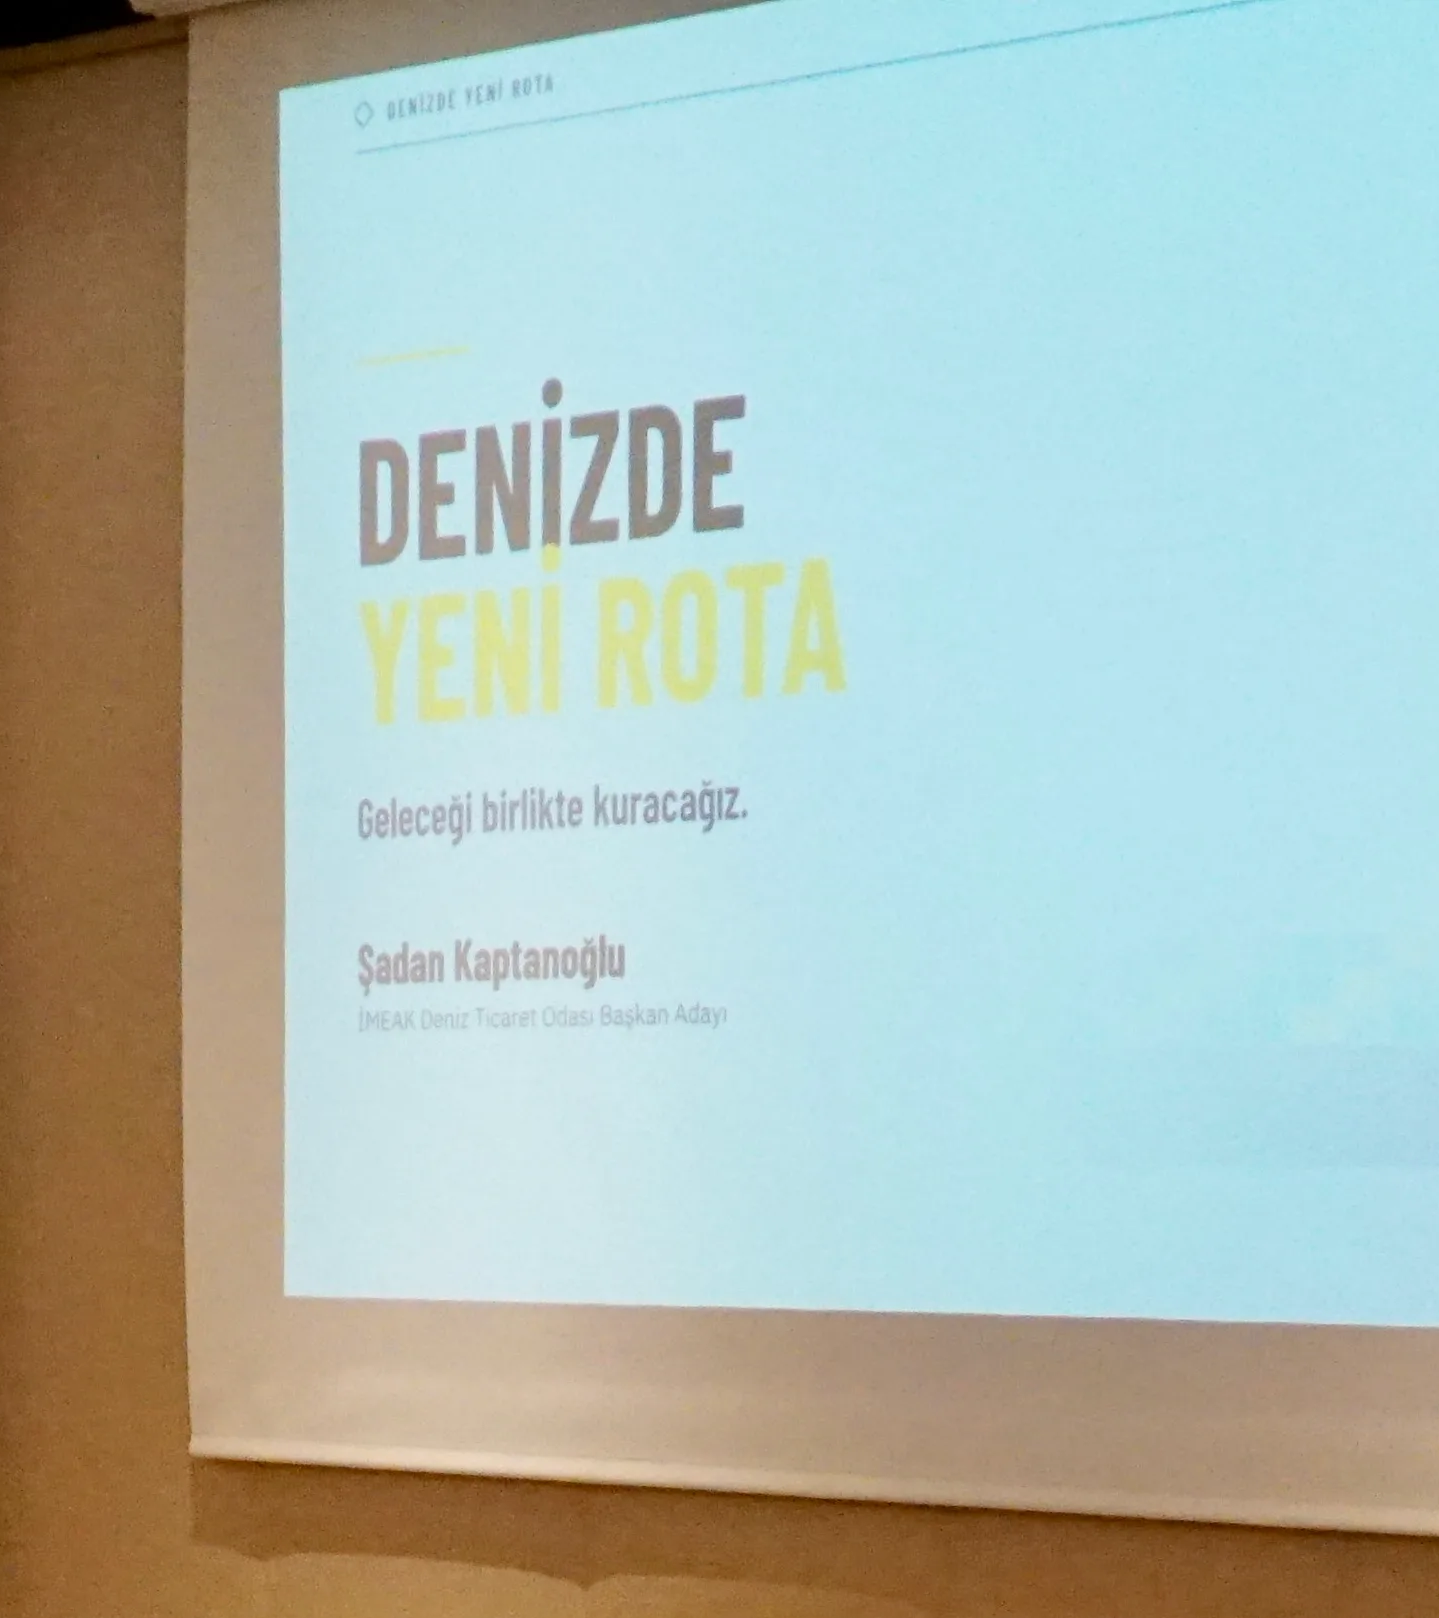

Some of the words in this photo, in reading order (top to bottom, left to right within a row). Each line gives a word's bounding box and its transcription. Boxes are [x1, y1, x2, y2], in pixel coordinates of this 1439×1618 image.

[511, 72, 554, 98] ROTA
[359, 377, 746, 567] DENİZDE
[360, 542, 562, 726] YENİ
[595, 557, 847, 710] ROTA
[357, 790, 472, 846] Geleceği
[482, 787, 584, 834] birlikte
[593, 780, 749, 834] kuracağız.
[357, 941, 445, 996] Şadan
[453, 934, 626, 990] Kaptanoğlu
[420, 1007, 470, 1032] Deniz
[542, 1005, 594, 1028] Odası
[599, 1003, 670, 1031] Başkan
[674, 1001, 728, 1029] Adayı
